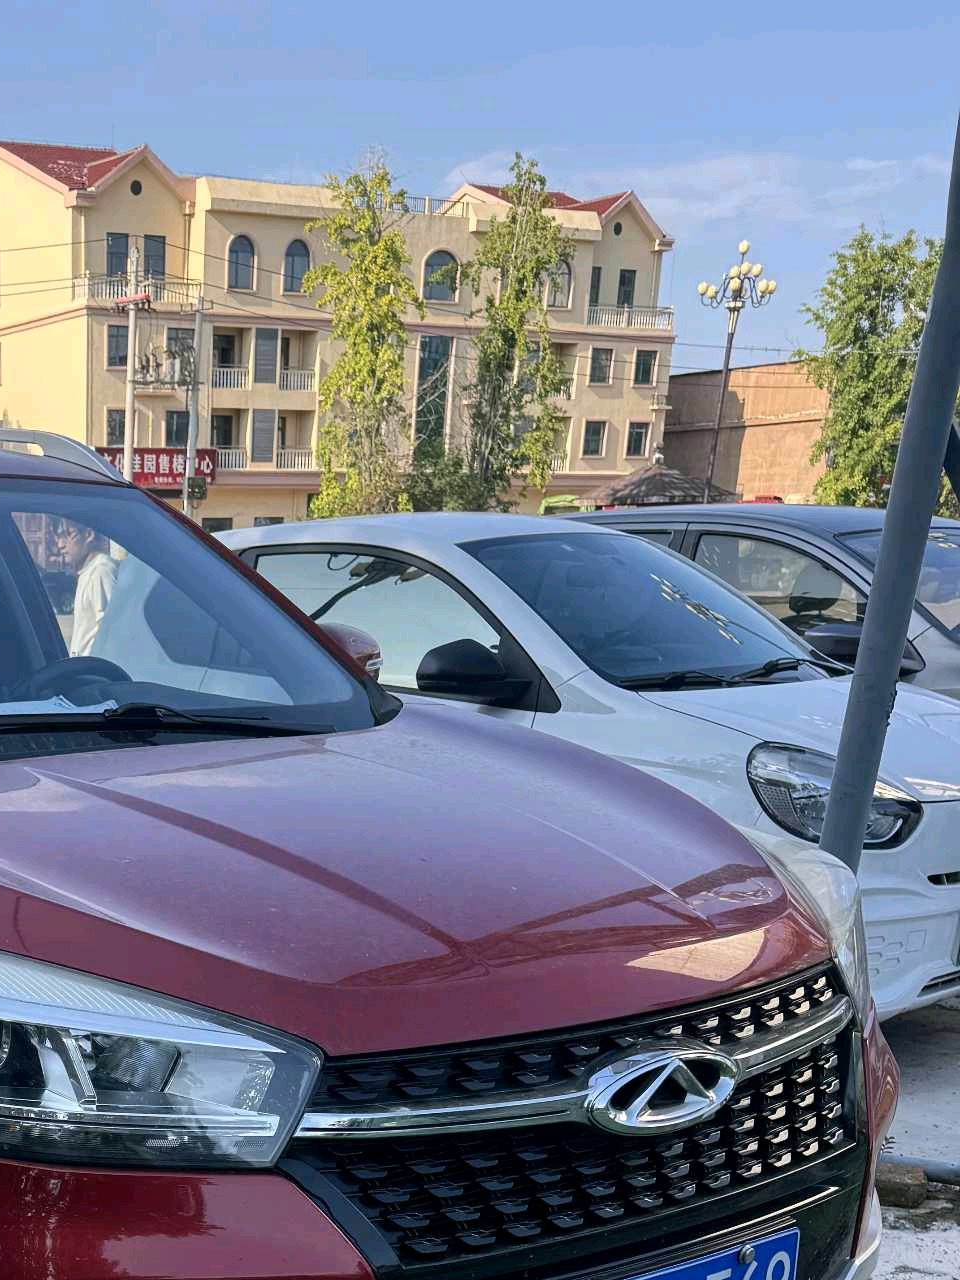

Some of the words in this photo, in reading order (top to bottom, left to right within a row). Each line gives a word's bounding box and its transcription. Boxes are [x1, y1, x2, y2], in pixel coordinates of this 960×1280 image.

[103, 452, 213, 474] 化佳园售楼心
